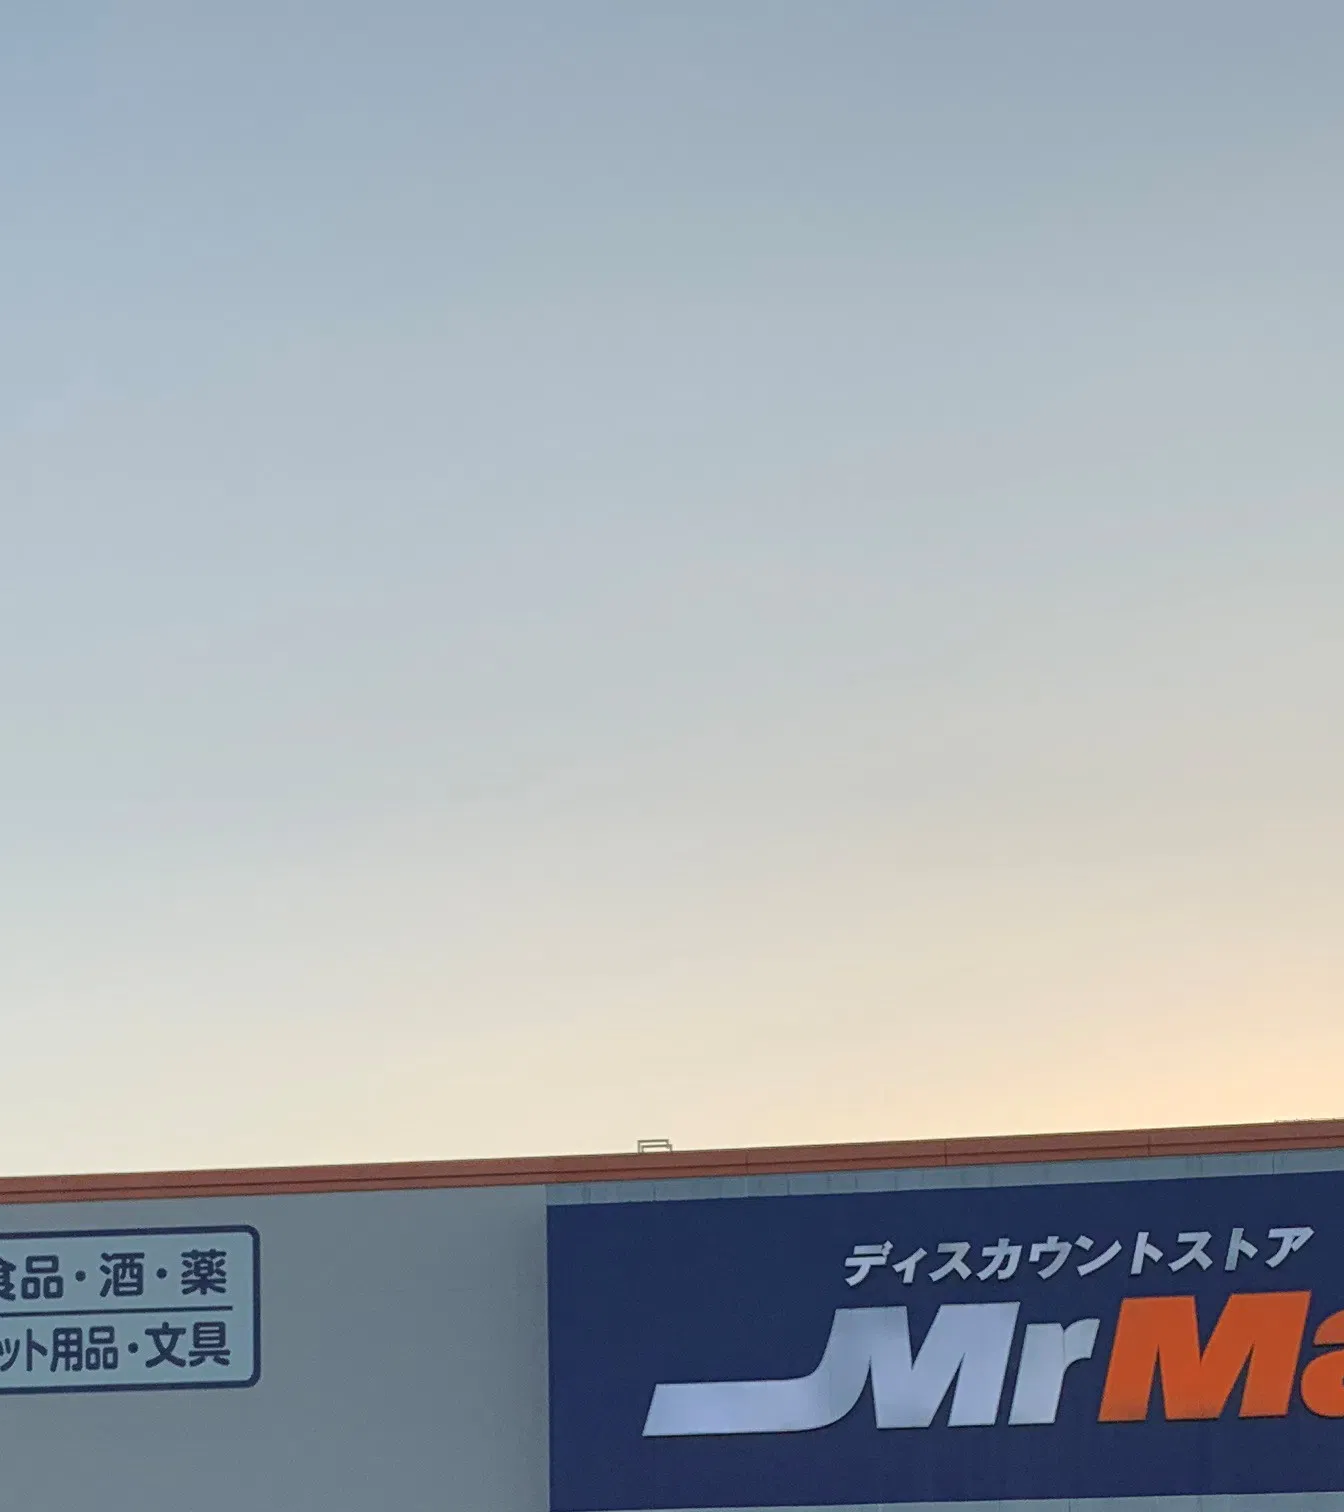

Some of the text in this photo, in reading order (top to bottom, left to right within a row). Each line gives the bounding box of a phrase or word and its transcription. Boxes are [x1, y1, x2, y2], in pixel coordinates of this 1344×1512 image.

[844, 1227, 1315, 1285] ディスカウントストア
